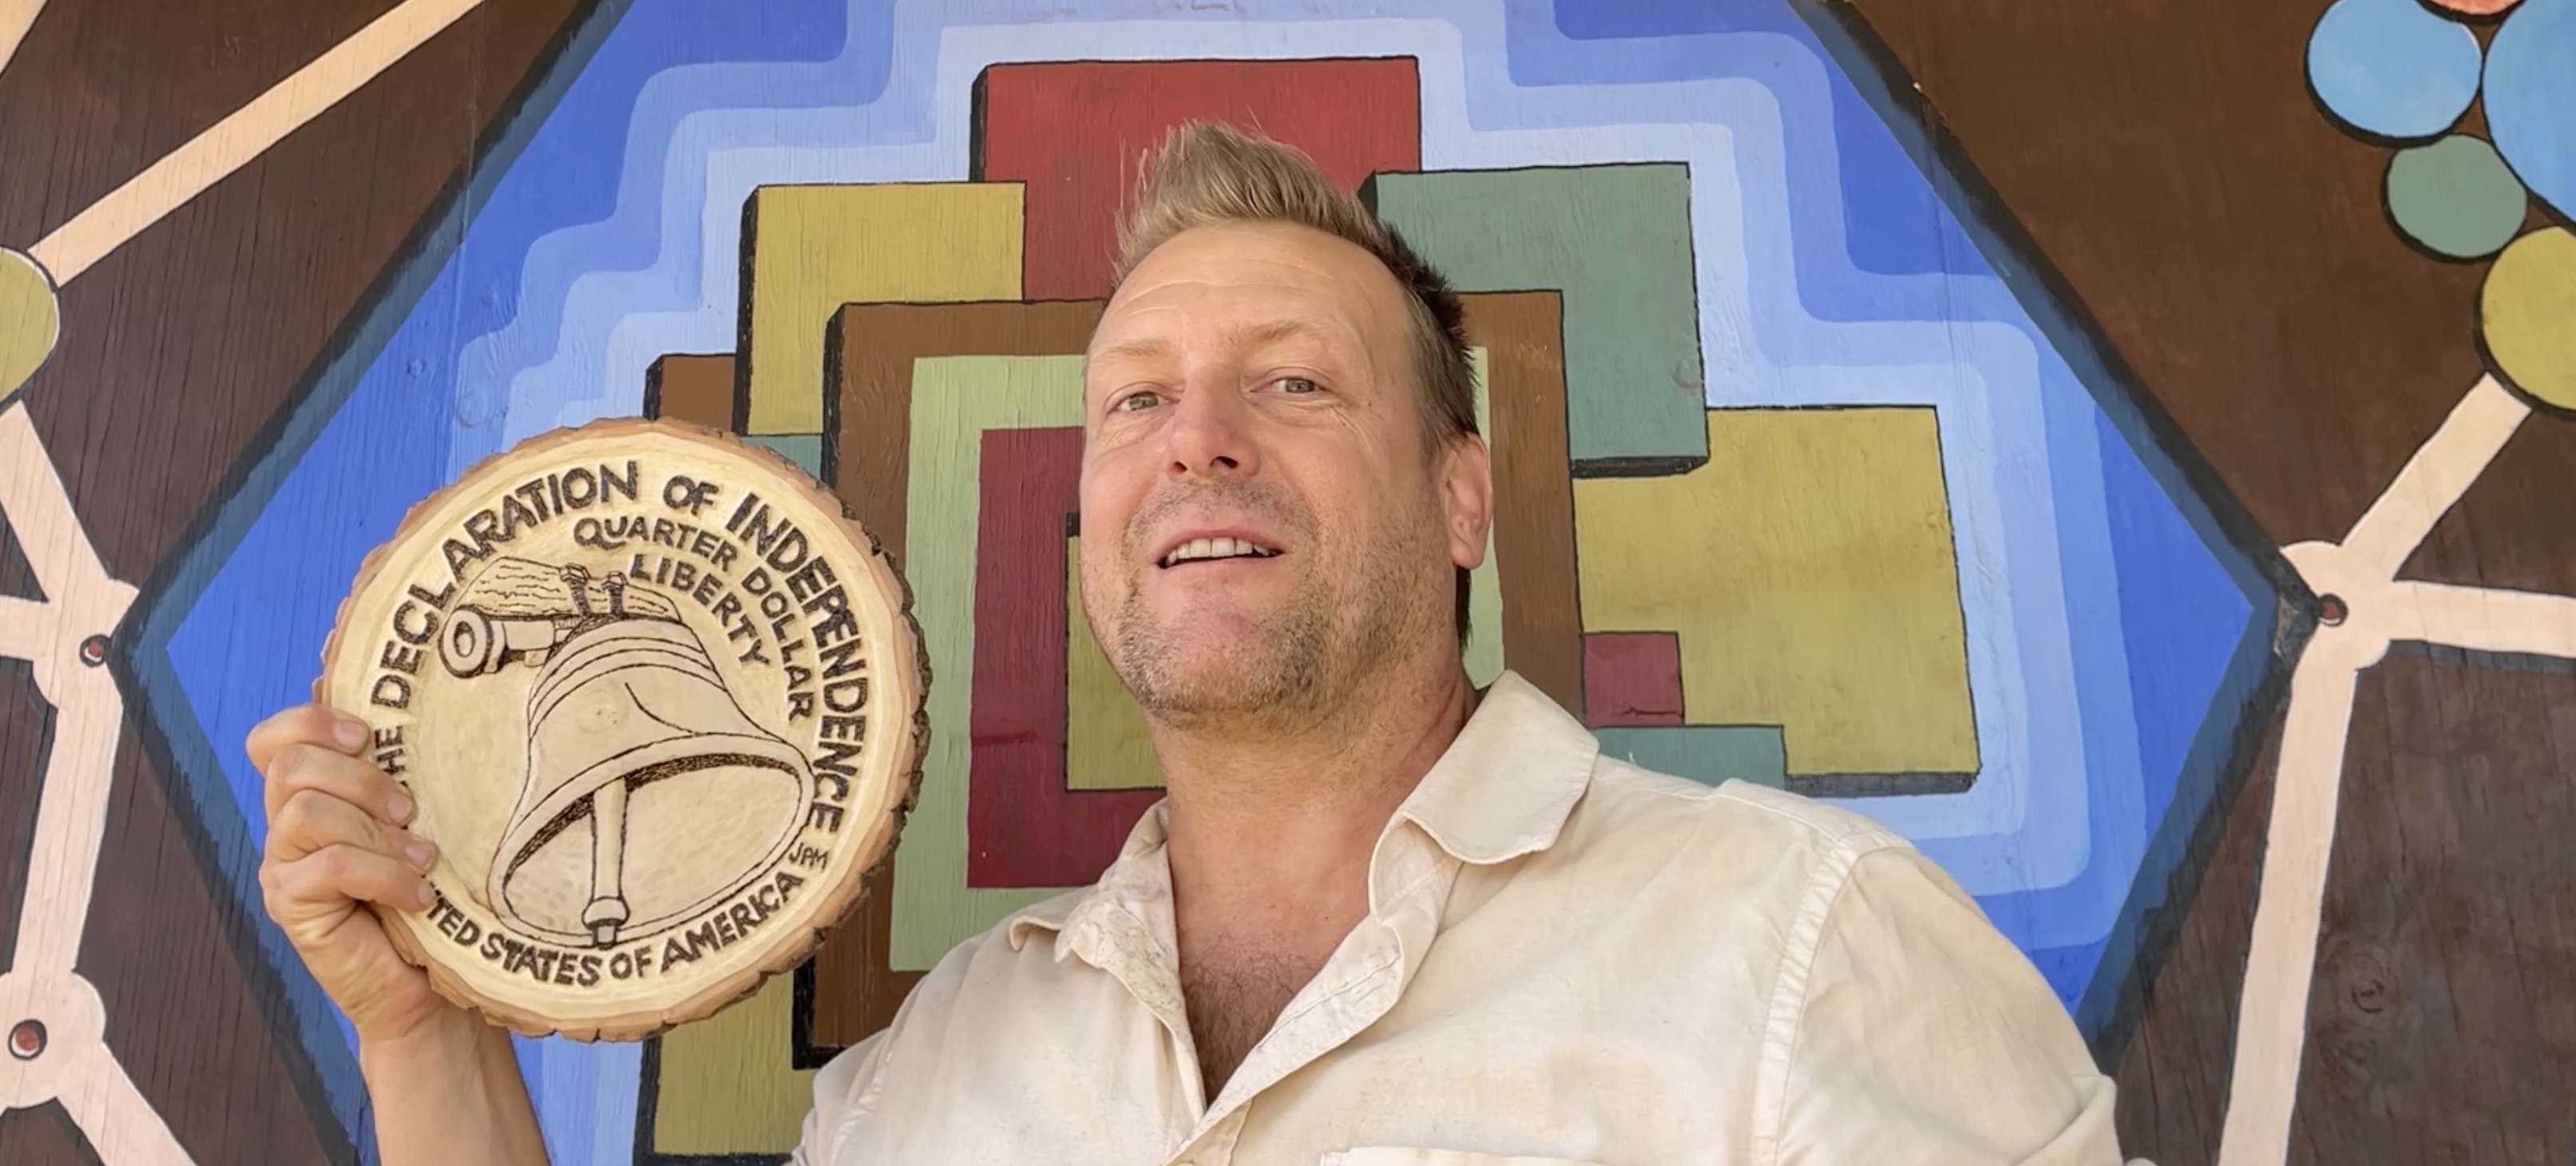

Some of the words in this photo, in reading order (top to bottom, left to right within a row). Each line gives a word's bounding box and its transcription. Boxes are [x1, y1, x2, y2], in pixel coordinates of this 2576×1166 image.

[663, 475, 719, 515] OF
[370, 459, 639, 709] DECLARATION
[573, 517, 738, 571] QUARTER
[740, 566, 814, 720] DOLLAR
[630, 553, 770, 665] LIBERTY
[725, 492, 868, 832] INDEPENDENCE
[375, 725, 406, 788] HE
[422, 875, 481, 946] TED
[481, 932, 602, 987] STATES
[609, 946, 651, 979] OF
[660, 871, 804, 973] AMERICA
